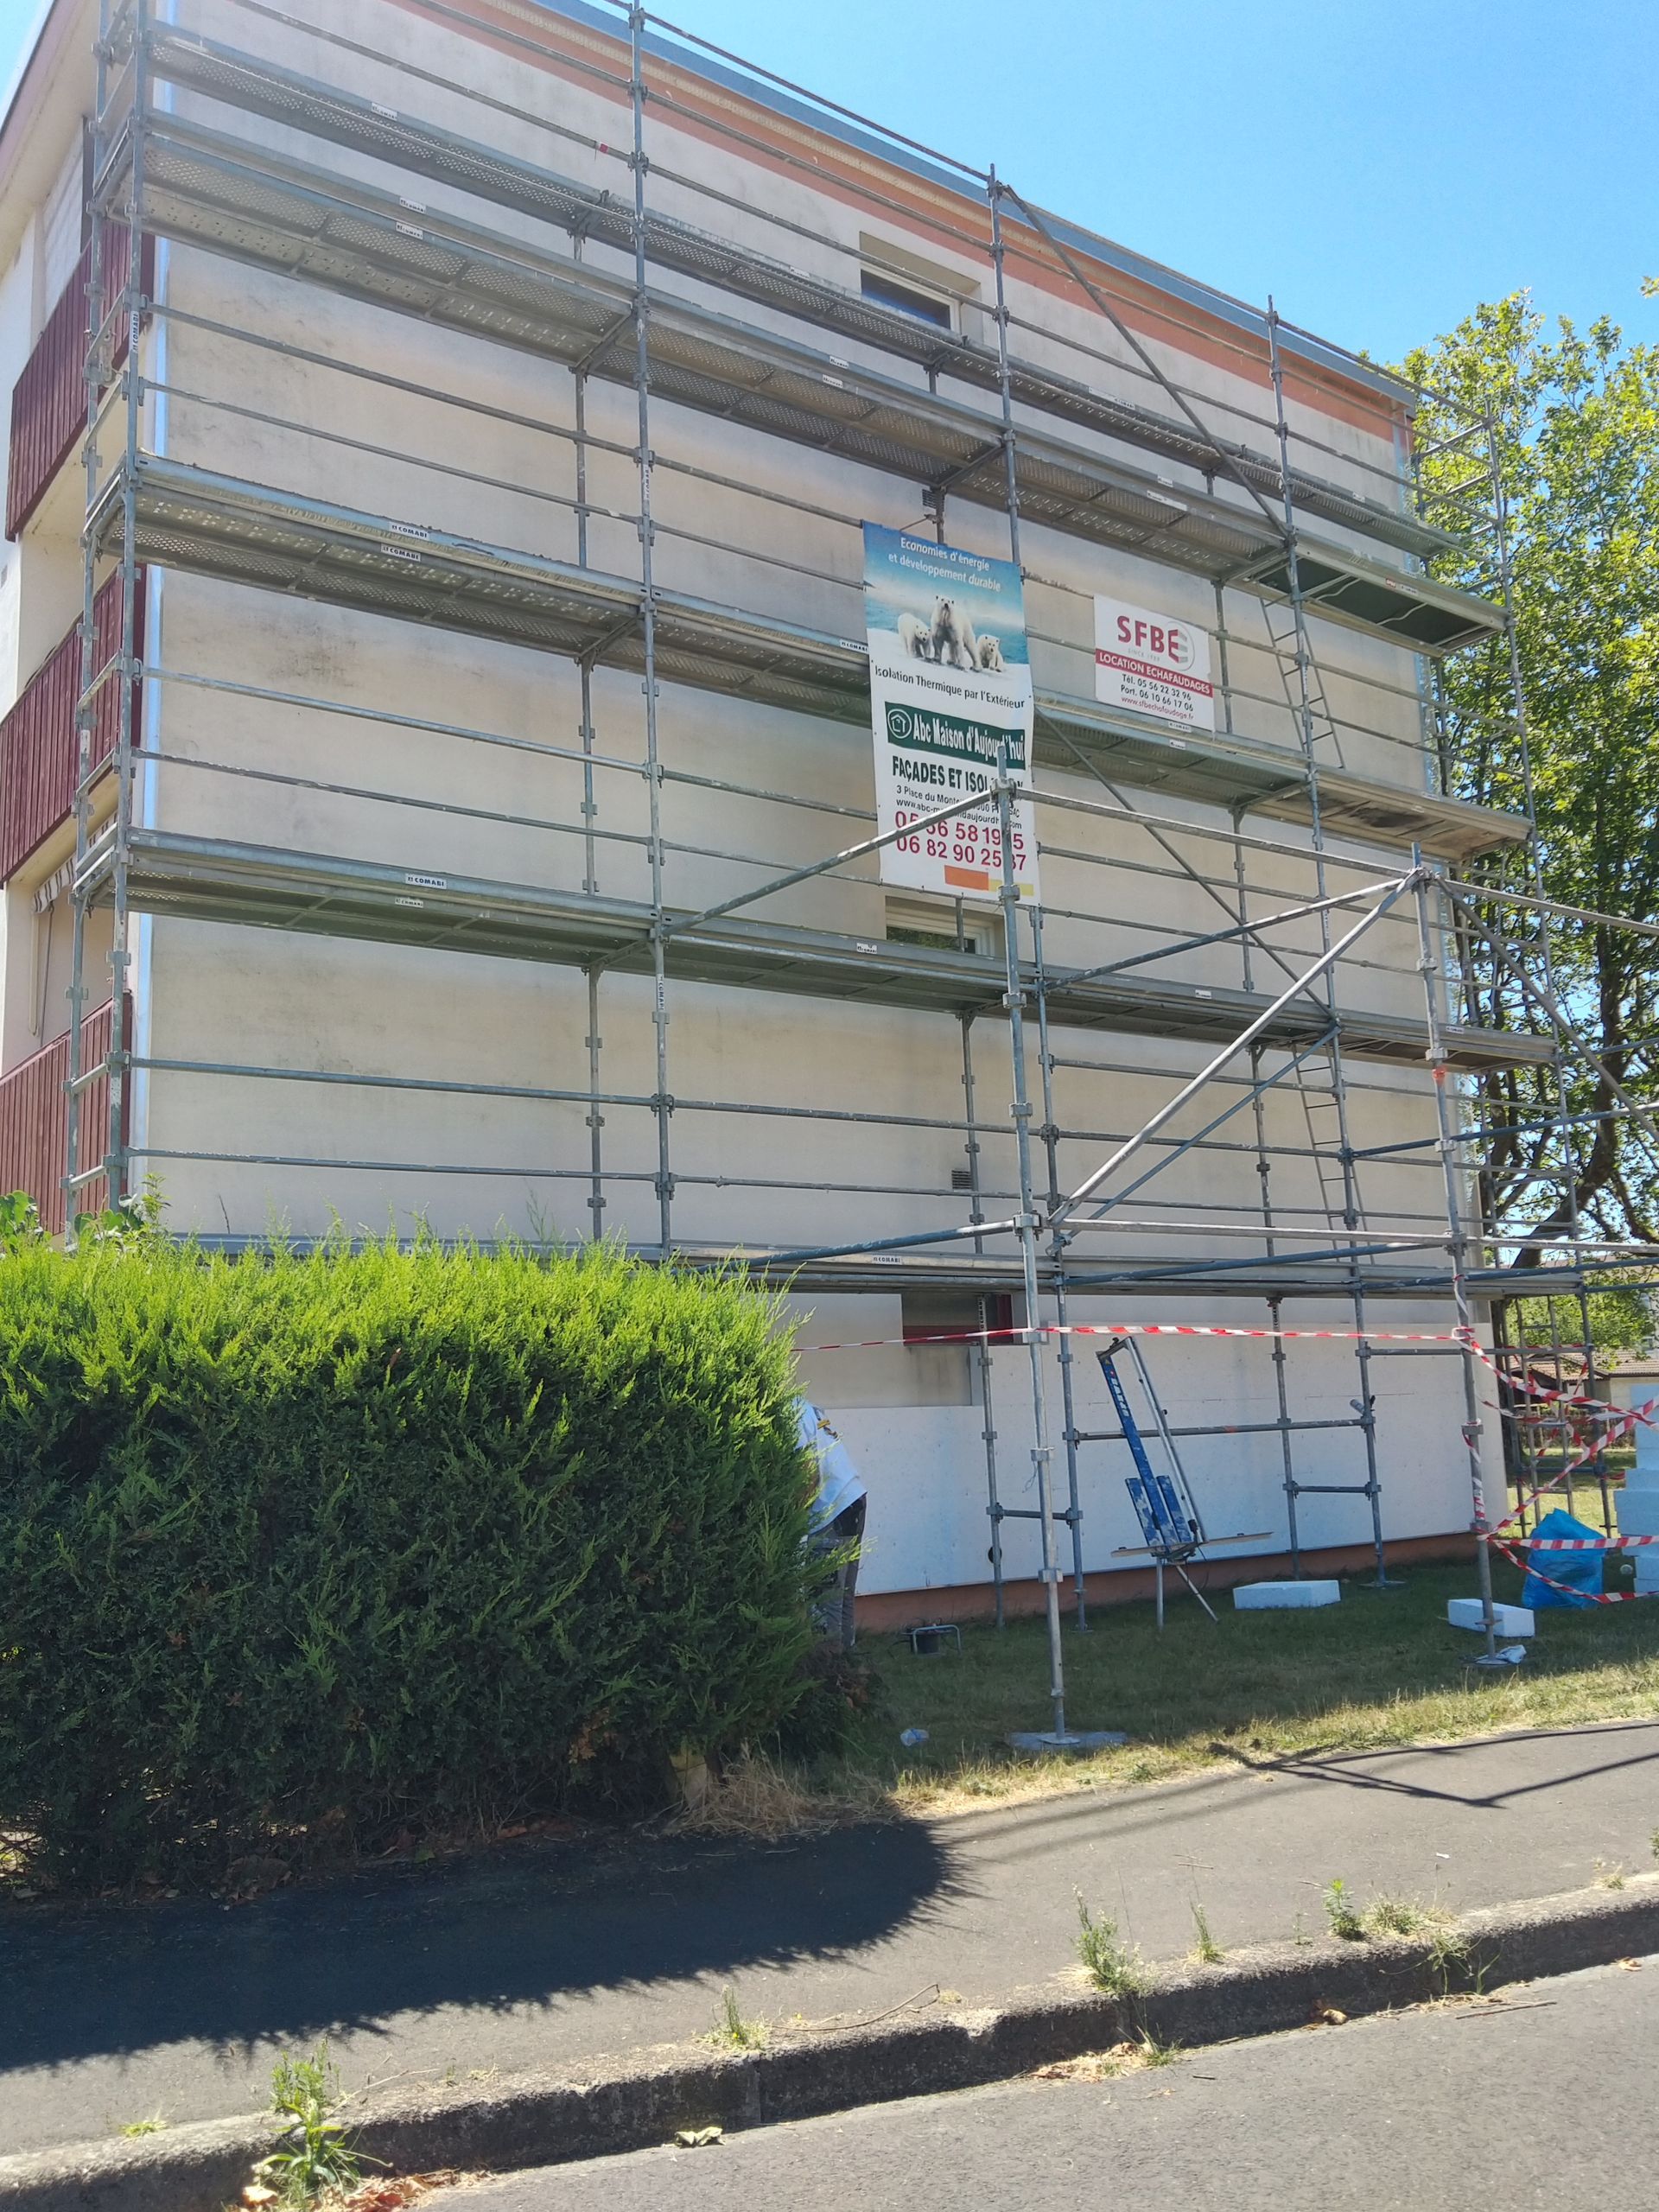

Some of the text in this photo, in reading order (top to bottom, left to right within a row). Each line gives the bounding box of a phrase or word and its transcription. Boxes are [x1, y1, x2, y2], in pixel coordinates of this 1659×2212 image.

[398, 525, 427, 537] COMABI
[390, 548, 418, 560] COMABI
[900, 537, 989, 571] Economies d'énergie
[888, 553, 1001, 592] et développement durable
[1116, 615, 1179, 664] SFBE
[875, 666, 1025, 709] Isolation Thermique par l'Extérieur
[1099, 652, 1211, 694] LOCATION ECHAFAUDAGES
[1122, 673, 1192, 701] Tél. 05 56 22 32 96
[1121, 684, 1193, 712] Port. 06 10 66 17 06
[913, 713, 931, 743] Abc
[932, 717, 965, 750] Maison
[893, 755, 945, 786] FAÇADES
[949, 767, 962, 789] ET
[897, 785, 901, 794] 3
[904, 785, 923, 799] Place
[925, 791, 935, 802] du
[938, 794, 964, 806] Monte
[956, 823, 978, 842] 58
[982, 827, 1001, 846] 19
[897, 836, 920, 854] 06
[927, 839, 948, 859] 82
[953, 844, 975, 863] 90
[981, 849, 1001, 867] 25
[415, 876, 444, 887] COMABI
